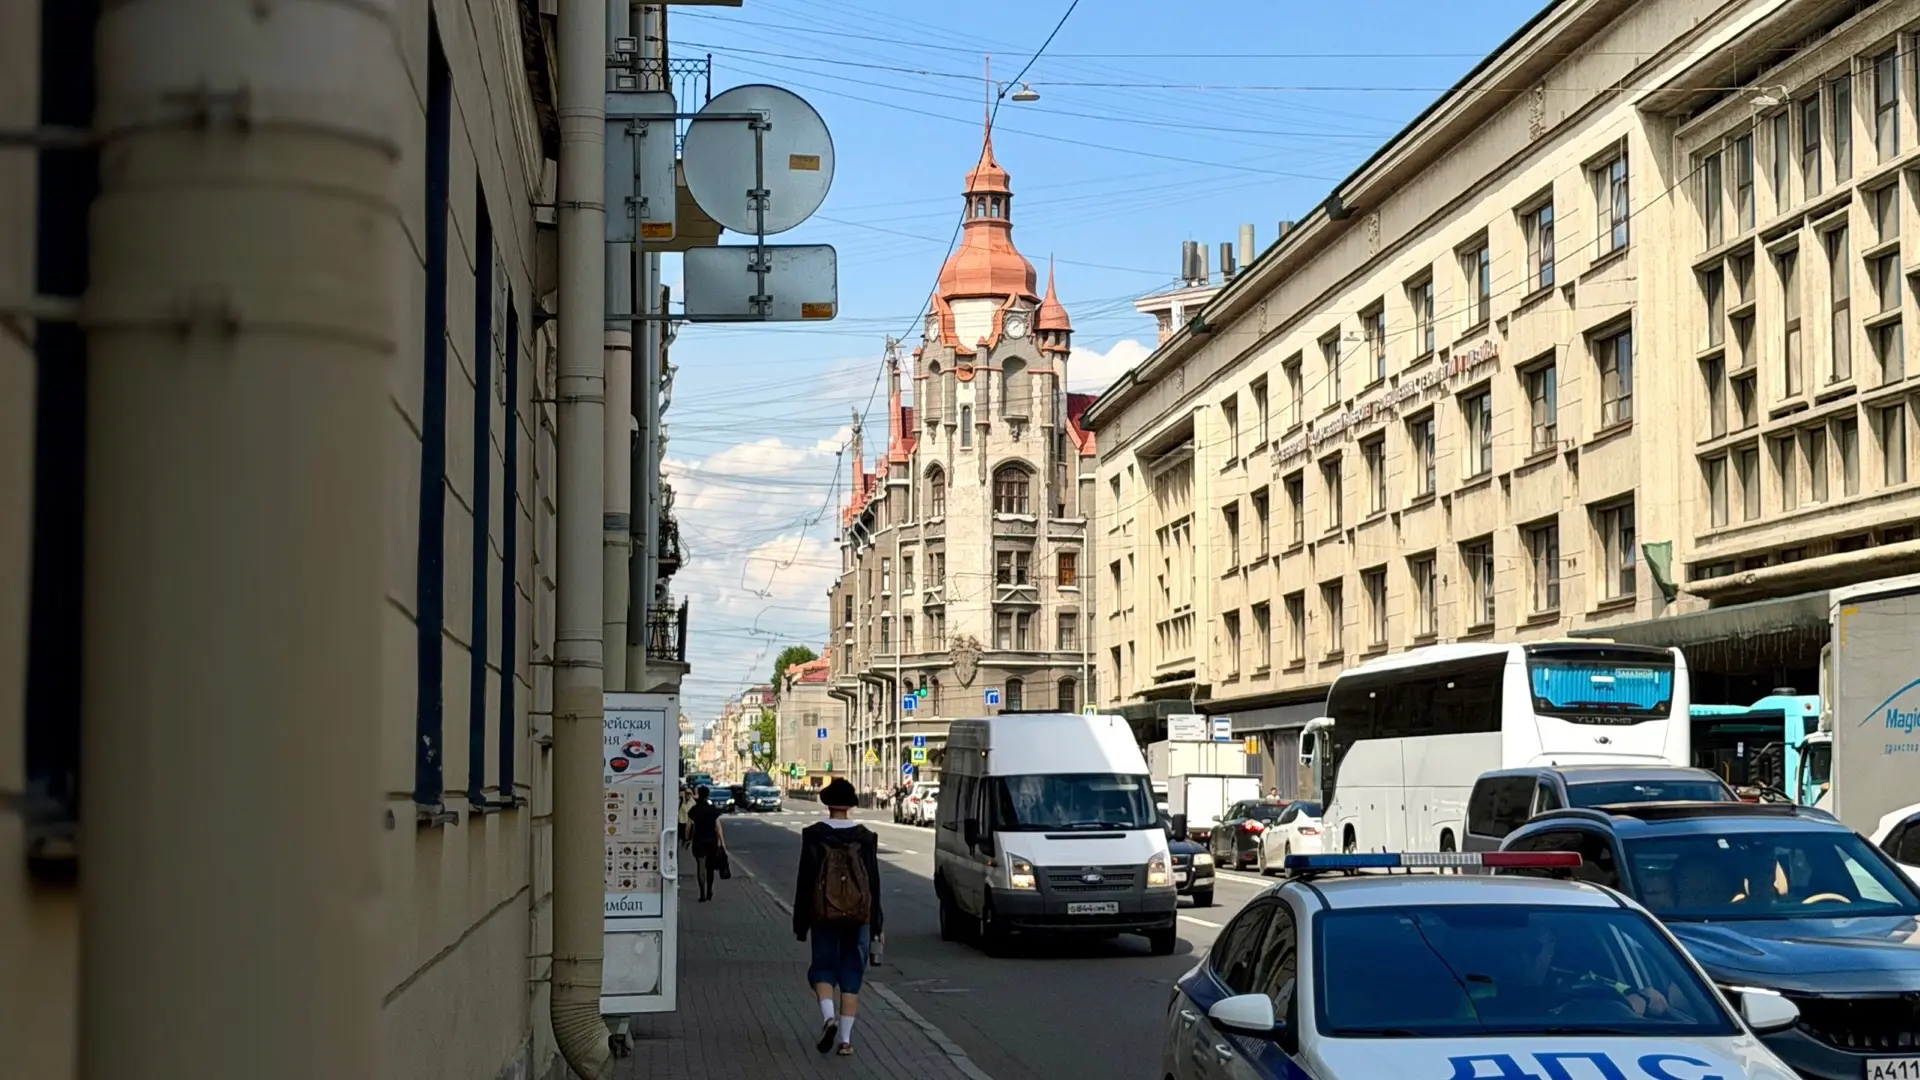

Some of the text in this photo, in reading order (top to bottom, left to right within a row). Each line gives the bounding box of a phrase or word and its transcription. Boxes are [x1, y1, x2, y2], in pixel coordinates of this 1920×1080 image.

[604, 735, 620, 745] ня
[1447, 1052, 1725, 1080] ДПС
[1874, 1060, 1920, 1080] А411
